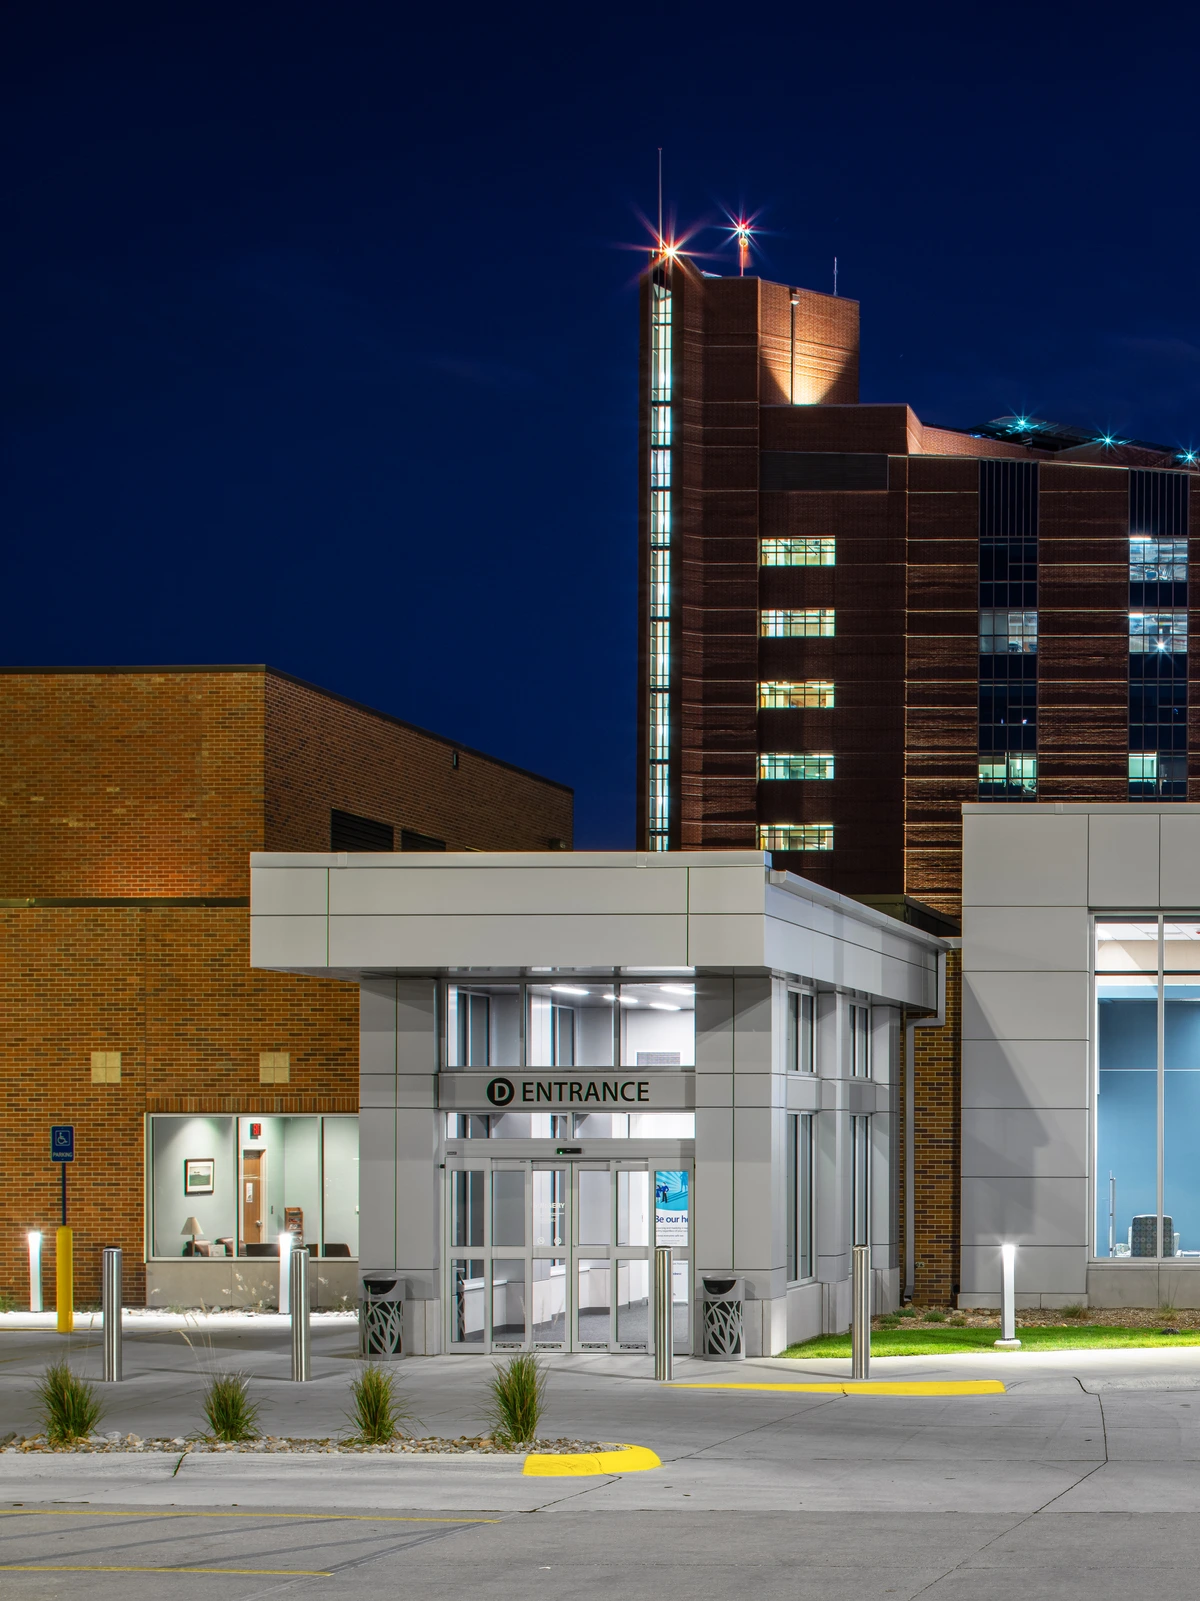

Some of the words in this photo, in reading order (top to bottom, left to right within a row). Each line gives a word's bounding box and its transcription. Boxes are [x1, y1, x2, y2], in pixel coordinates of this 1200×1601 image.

[492, 1081, 511, 1102] D
[522, 1081, 650, 1102] ENTRANCE
[655, 1214, 664, 1223] Be
